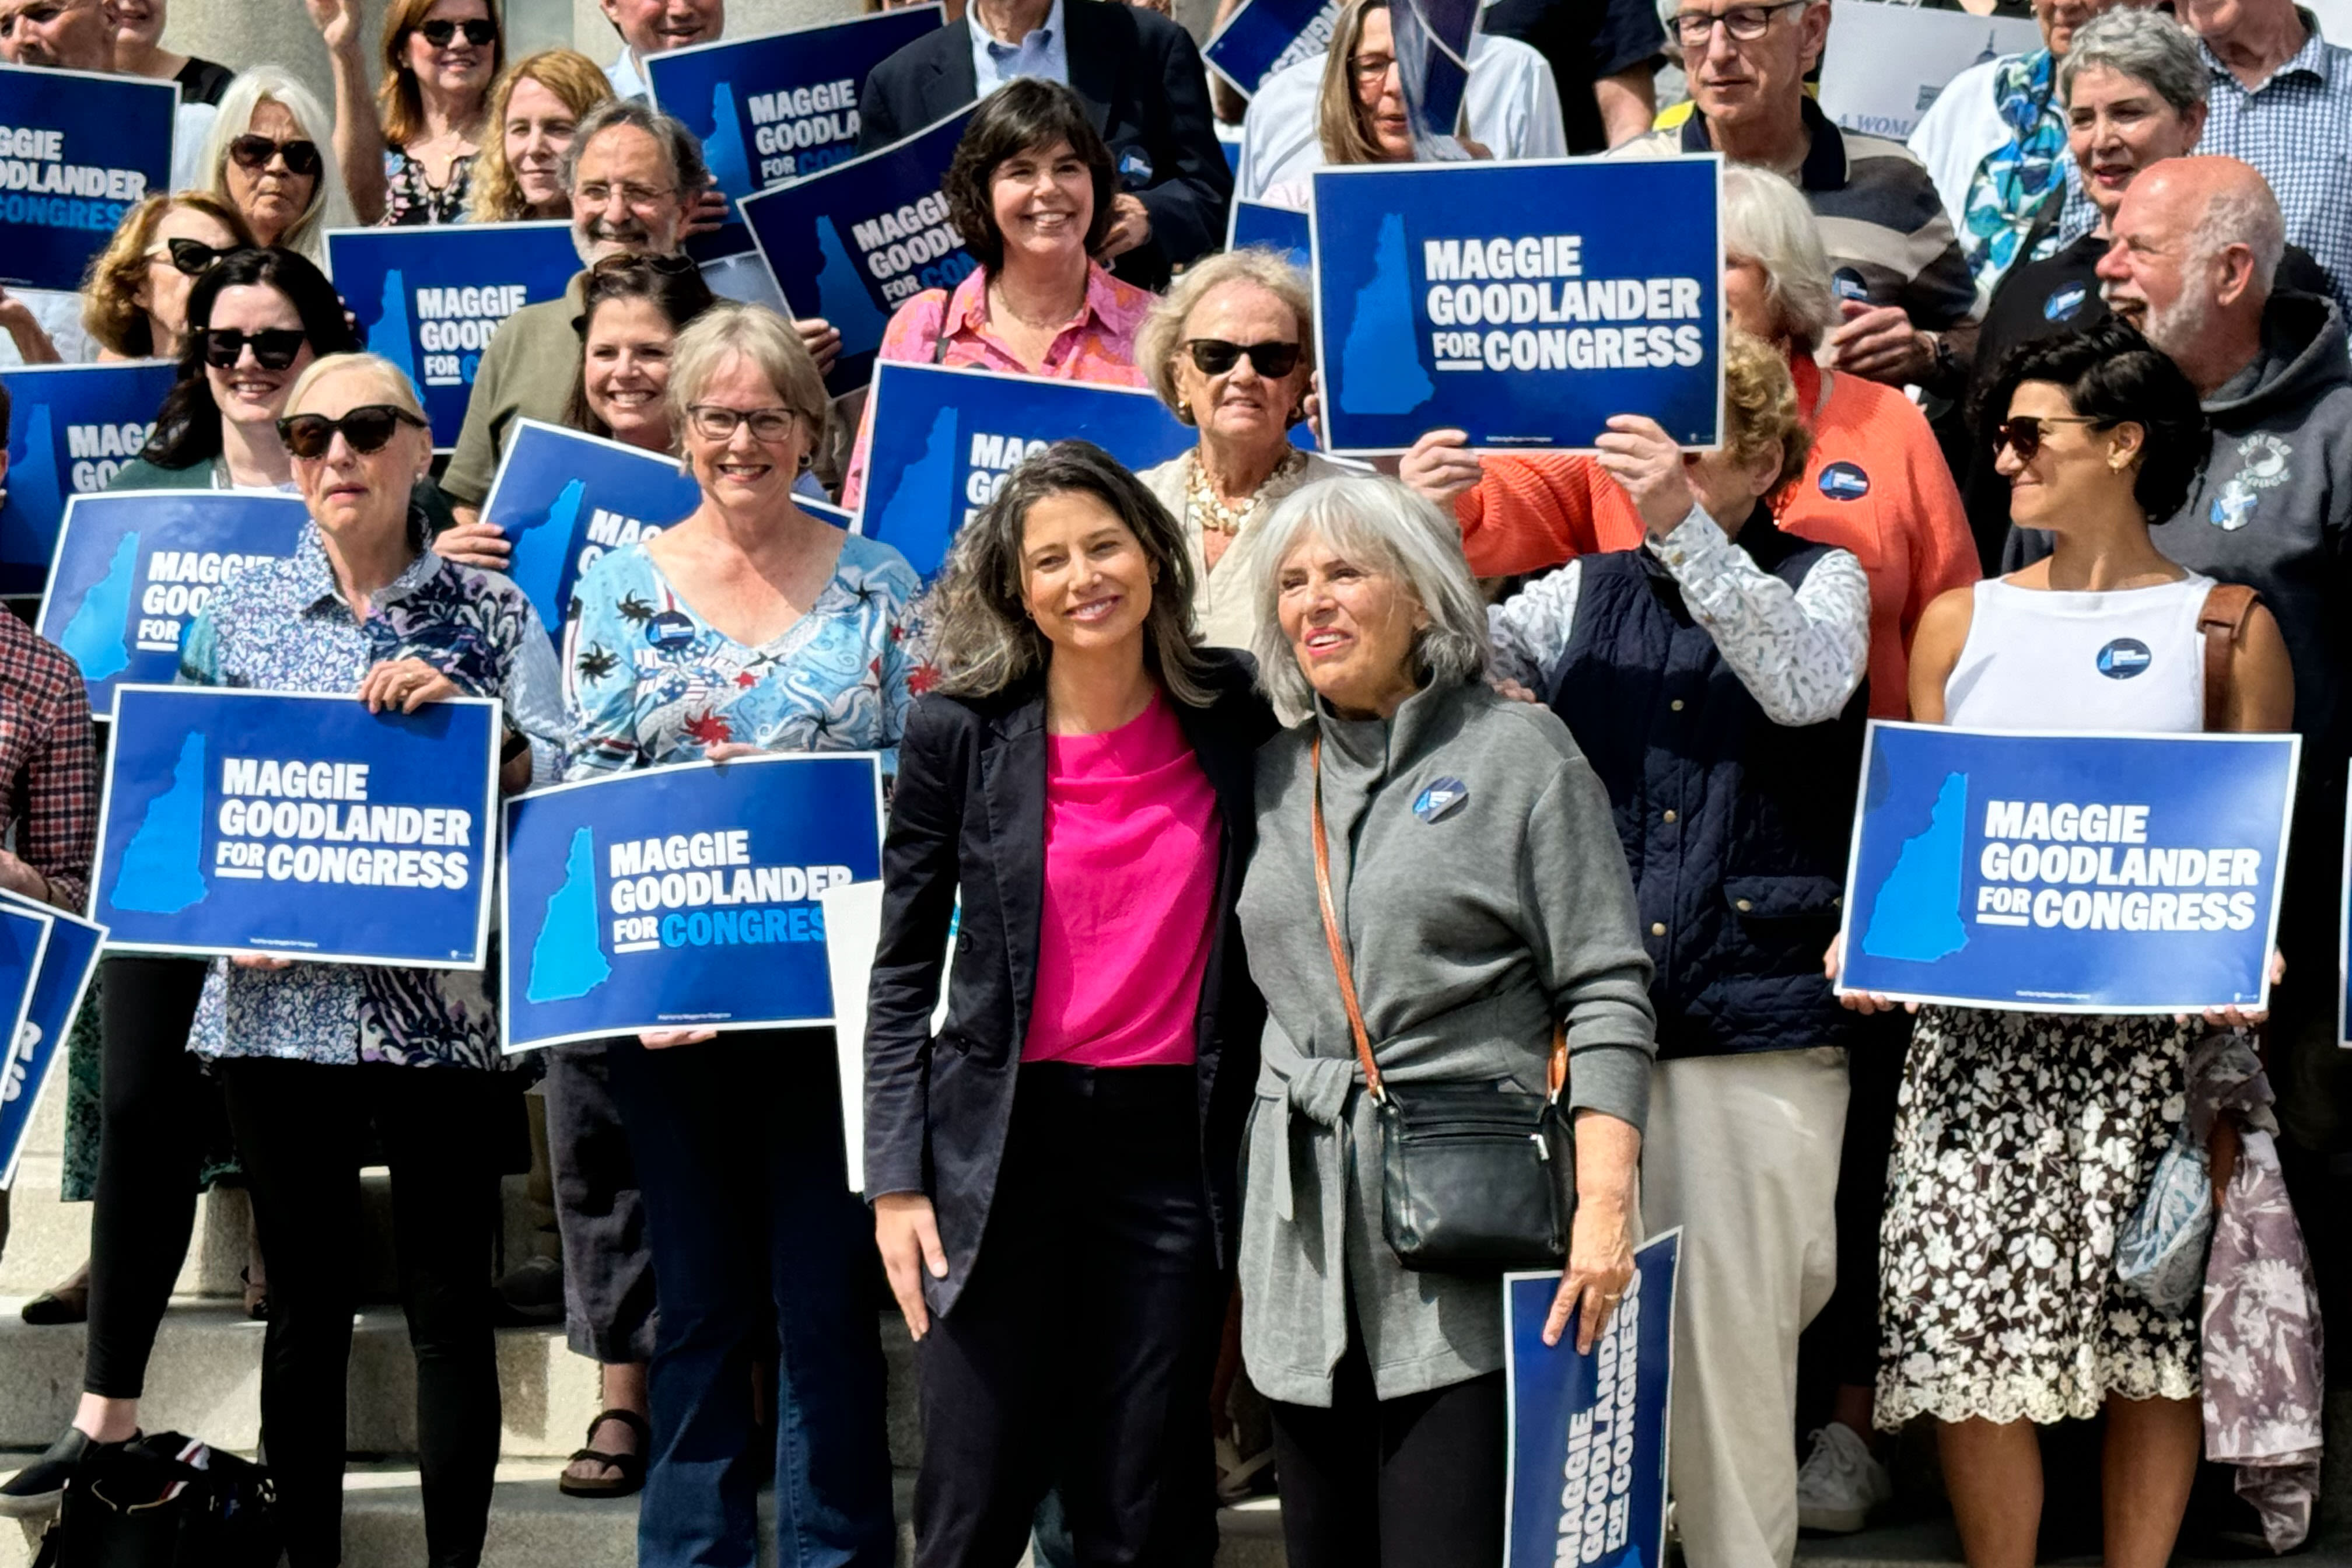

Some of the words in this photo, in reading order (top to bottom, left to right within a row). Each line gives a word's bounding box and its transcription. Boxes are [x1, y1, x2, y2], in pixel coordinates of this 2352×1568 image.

[748, 79, 858, 125] MAGGIE
[0, 125, 64, 162] GGIE
[756, 109, 862, 155] GOODLA
[0, 159, 147, 202] DLANDER
[761, 155, 796, 178] FOR
[0, 193, 124, 231] ONGRES
[852, 190, 951, 253] MAGGI
[868, 222, 967, 279] GOODL
[1424, 235, 1583, 281] MAGGIE
[881, 274, 922, 302] FOR
[1427, 277, 1702, 326] GOODLANDER
[424, 355, 461, 377] FOR
[1432, 331, 1482, 358] FOR
[1483, 324, 1704, 372] CONGRESS
[67, 422, 158, 459] MAG
[148, 551, 275, 584] MAGG
[138, 619, 181, 641] FOR
[222, 758, 370, 801] MAGGIE
[218, 799, 472, 846] GOODLANDER
[1985, 800, 2151, 844] MAGGIE
[216, 841, 266, 867] FOR
[267, 844, 470, 890] CONGRESS
[610, 830, 750, 878] MAGGIE
[1980, 842, 2262, 887] GOODLANDER
[613, 916, 659, 943] FOR
[661, 906, 825, 949] CONGRES
[1978, 886, 2031, 914] FOR
[2033, 888, 2256, 931] CONGRESS
[1611, 1268, 1642, 1495] CONGRESS
[1580, 1307, 1619, 1564] GOODLANDE
[1554, 1406, 1594, 1568] MAGGIE
[1605, 1497, 1623, 1553] FOR
